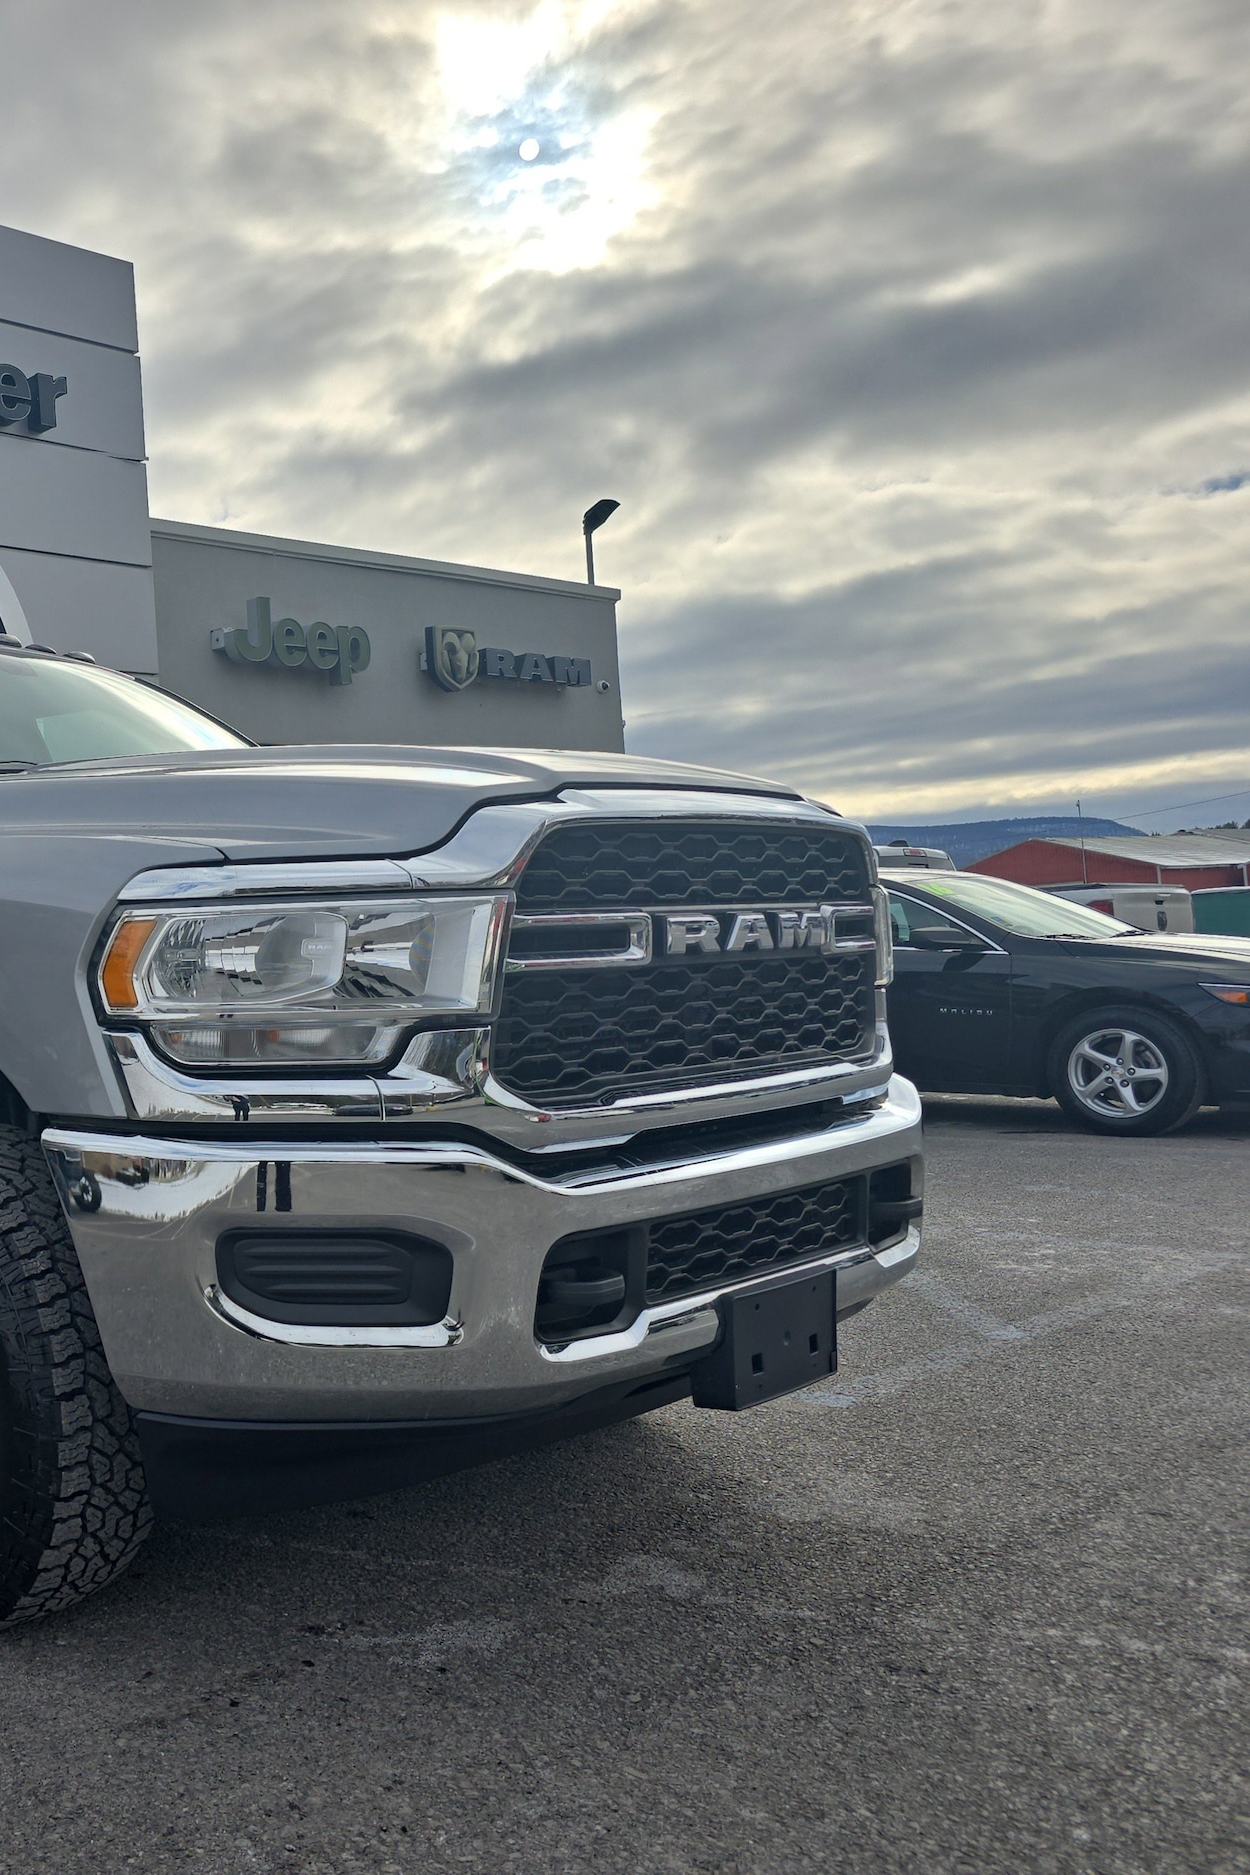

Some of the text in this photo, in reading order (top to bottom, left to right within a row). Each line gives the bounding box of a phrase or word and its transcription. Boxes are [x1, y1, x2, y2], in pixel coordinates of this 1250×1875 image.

[223, 596, 371, 686] Jeep
[478, 647, 592, 688] RAM
[666, 913, 822, 954] RAM
[939, 1007, 993, 1016] MALIBU
